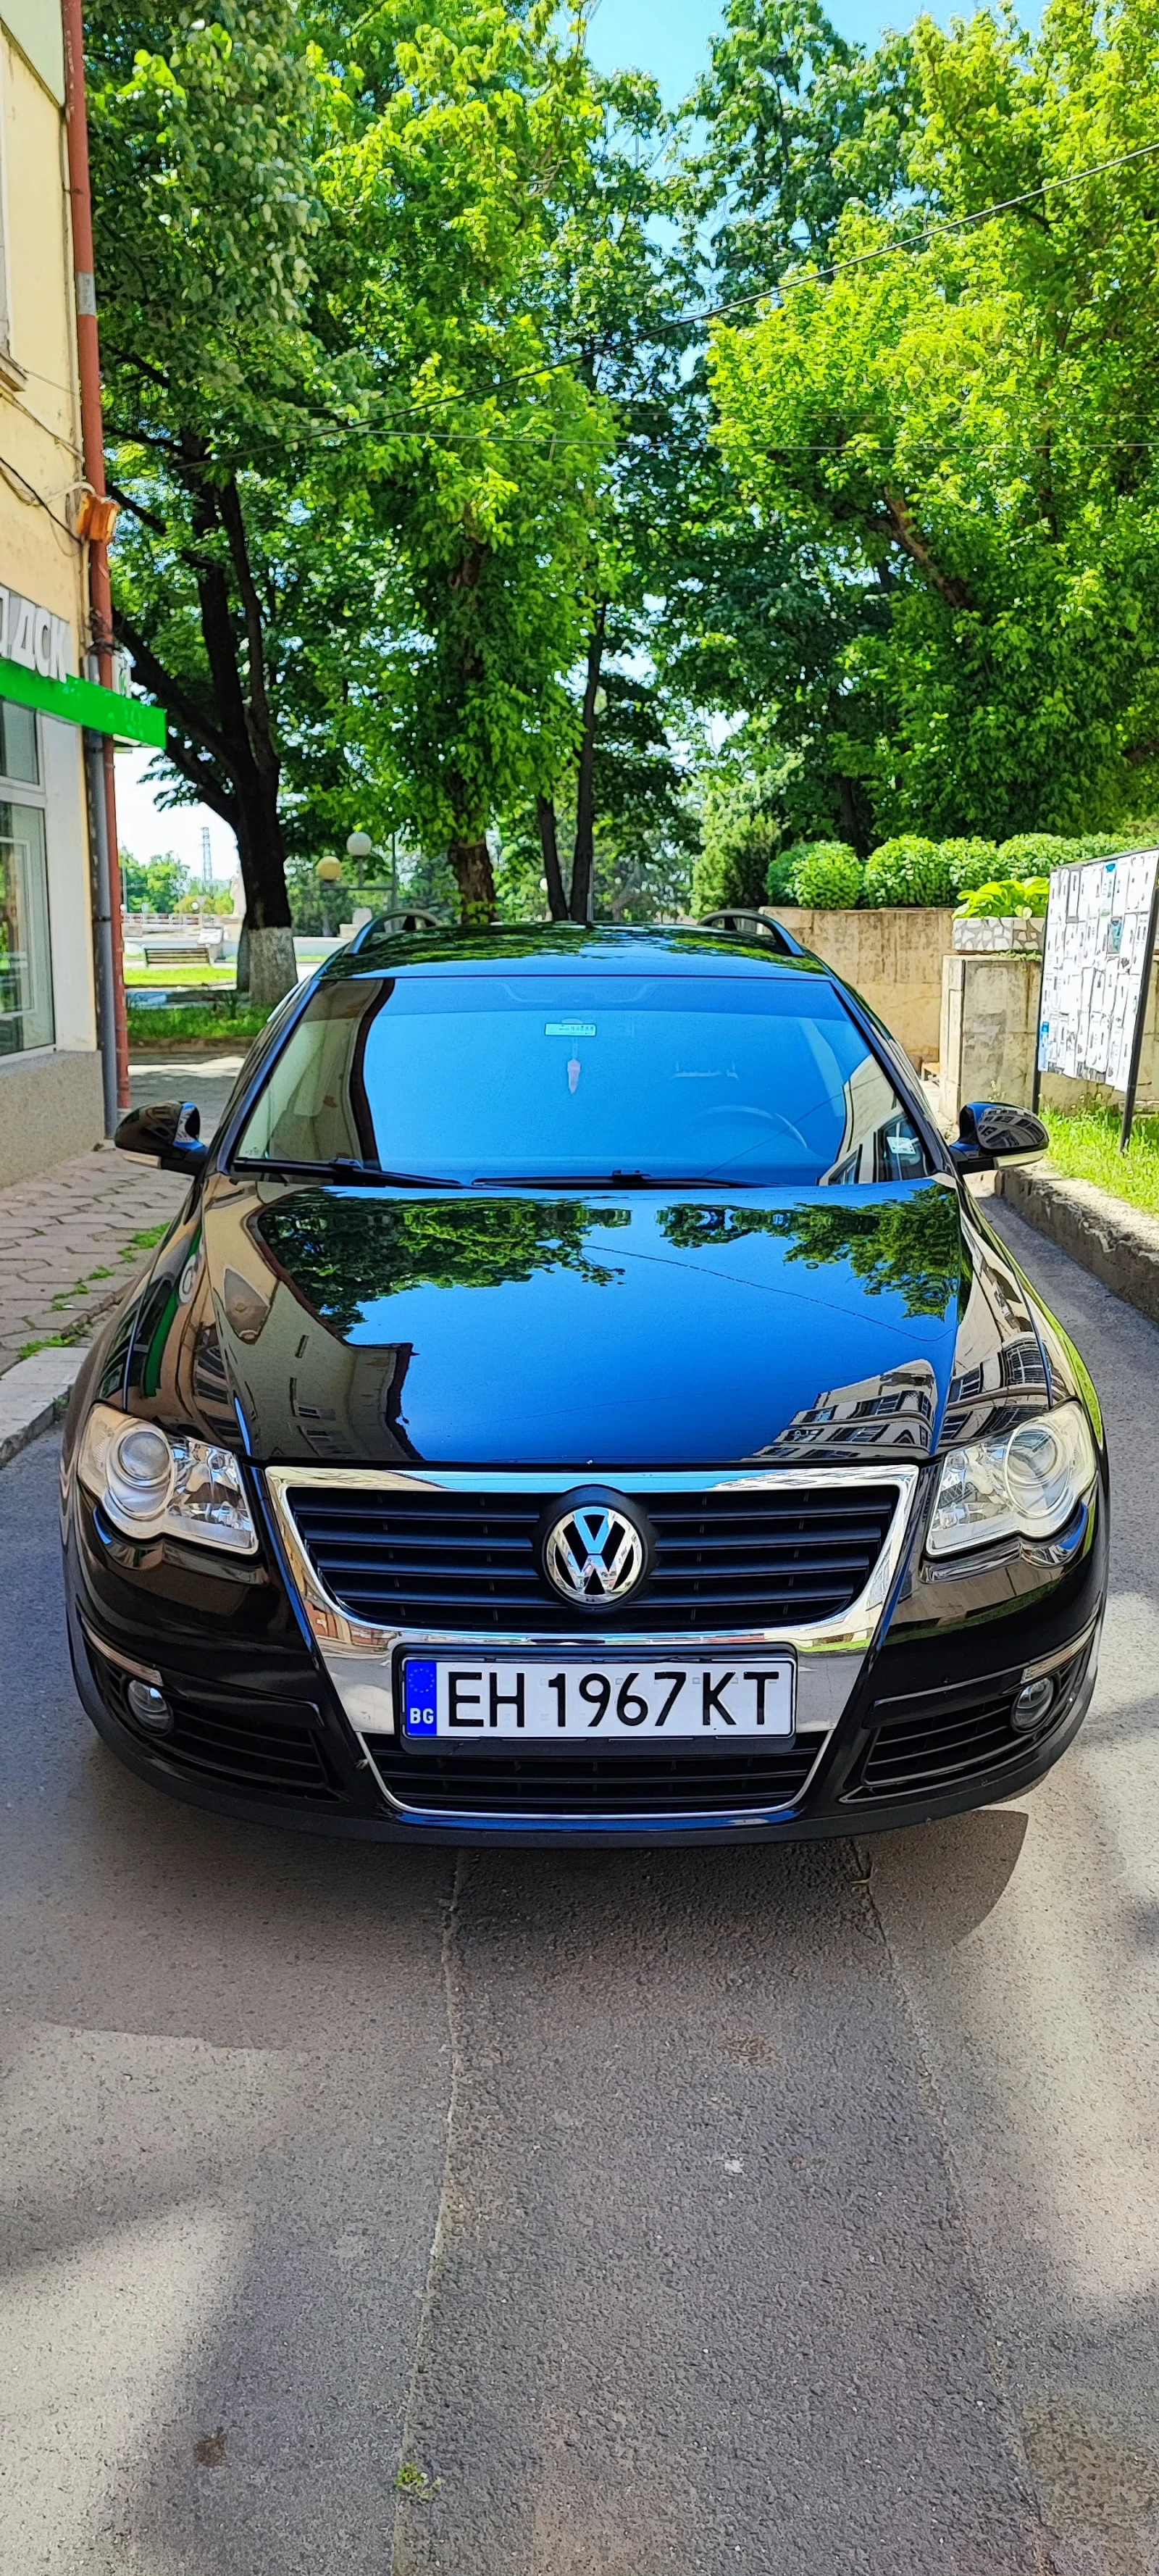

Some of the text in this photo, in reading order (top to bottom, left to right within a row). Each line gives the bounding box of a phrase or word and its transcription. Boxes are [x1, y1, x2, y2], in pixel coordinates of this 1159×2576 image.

[547, 1506, 642, 1604] VW
[409, 1707, 434, 1725] BG
[448, 1671, 779, 1727] EH 1967 KT
